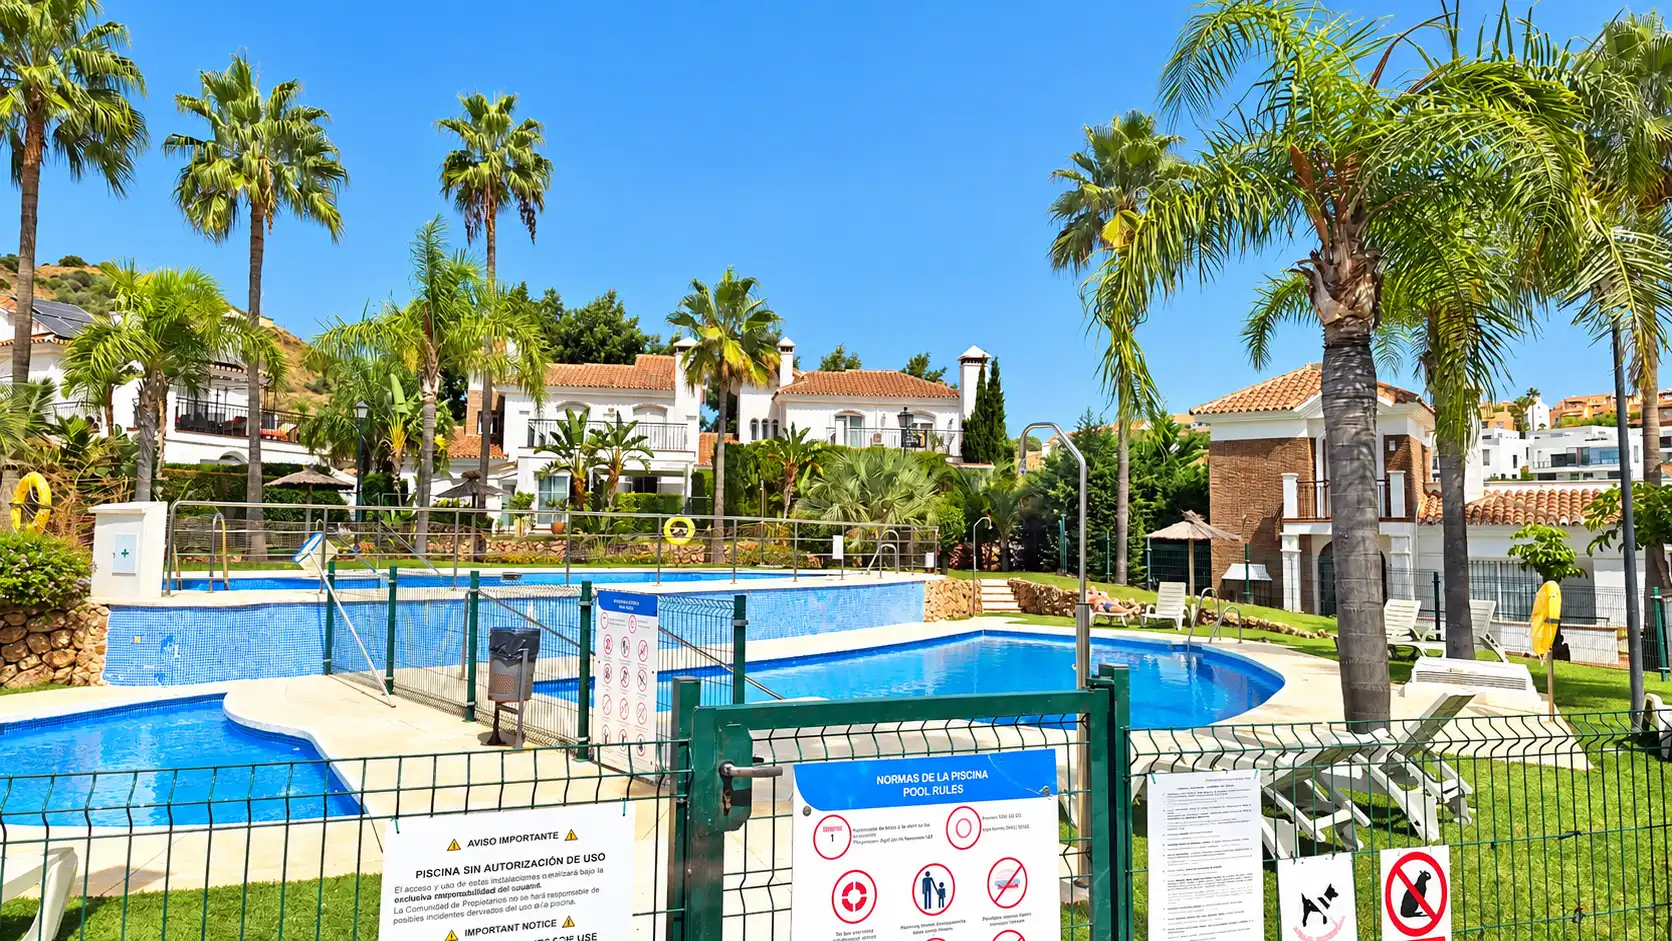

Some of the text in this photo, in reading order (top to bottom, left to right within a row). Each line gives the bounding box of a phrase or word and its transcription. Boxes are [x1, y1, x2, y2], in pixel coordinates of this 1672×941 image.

[877, 770, 988, 784] NORMAS DE LA PISCINA
[903, 784, 964, 797] POOL RULES
[467, 831, 559, 848] AVISO IMPORTANTE
[415, 853, 606, 878] PISCINA SIN AUTORIZACIÓN DE USO
[434, 884, 440, 892] y
[464, 919, 557, 937] IMPORTANT NOTICE
